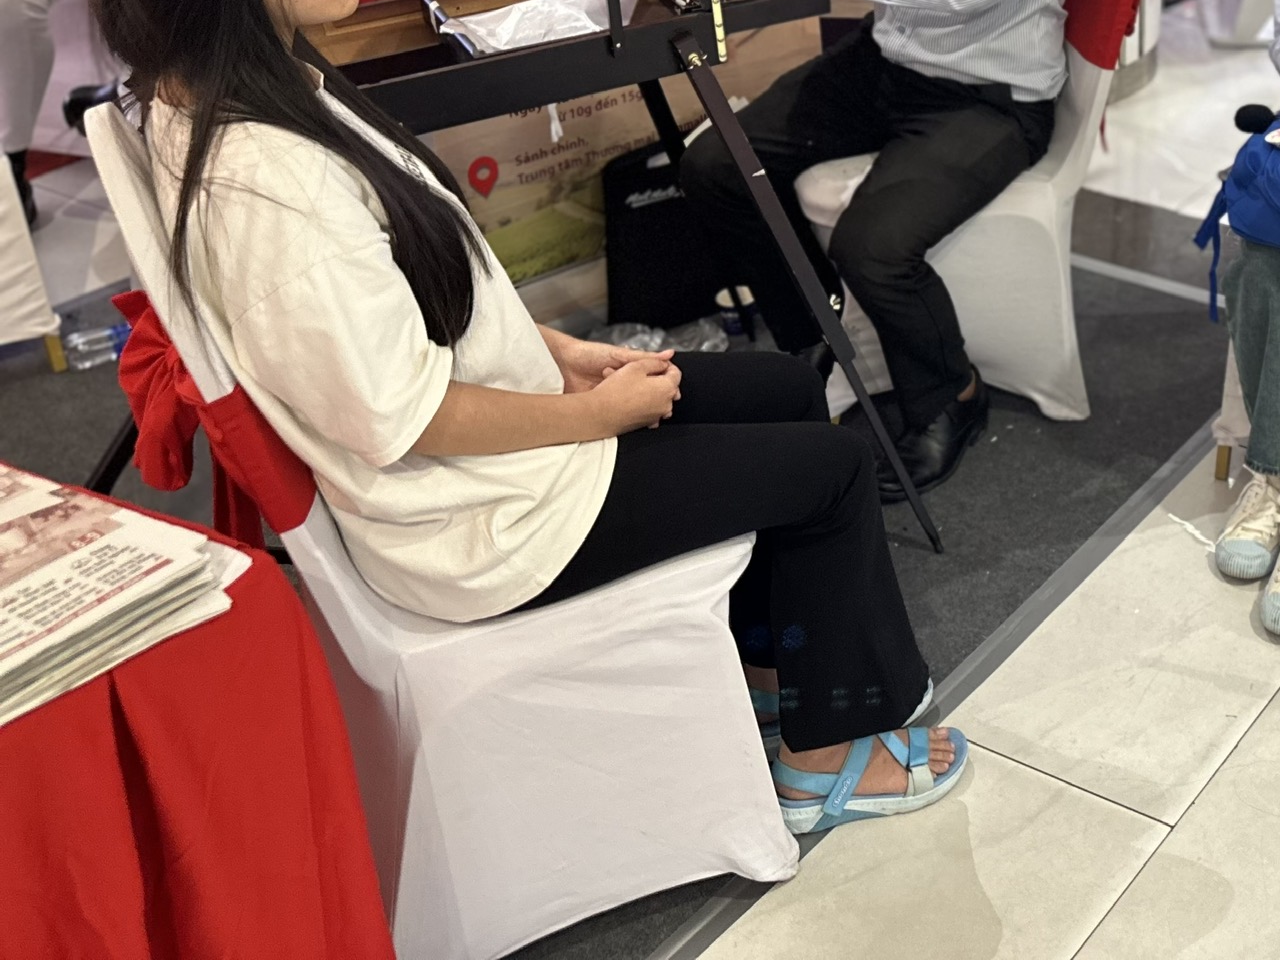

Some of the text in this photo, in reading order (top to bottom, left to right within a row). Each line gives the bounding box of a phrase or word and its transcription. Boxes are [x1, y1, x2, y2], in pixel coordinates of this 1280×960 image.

[569, 104, 593, 121] 10g
[595, 95, 618, 112] đến
[514, 136, 589, 166] Sảnh chính,
[517, 166, 557, 185] Trung
[558, 156, 584, 172] tâm
